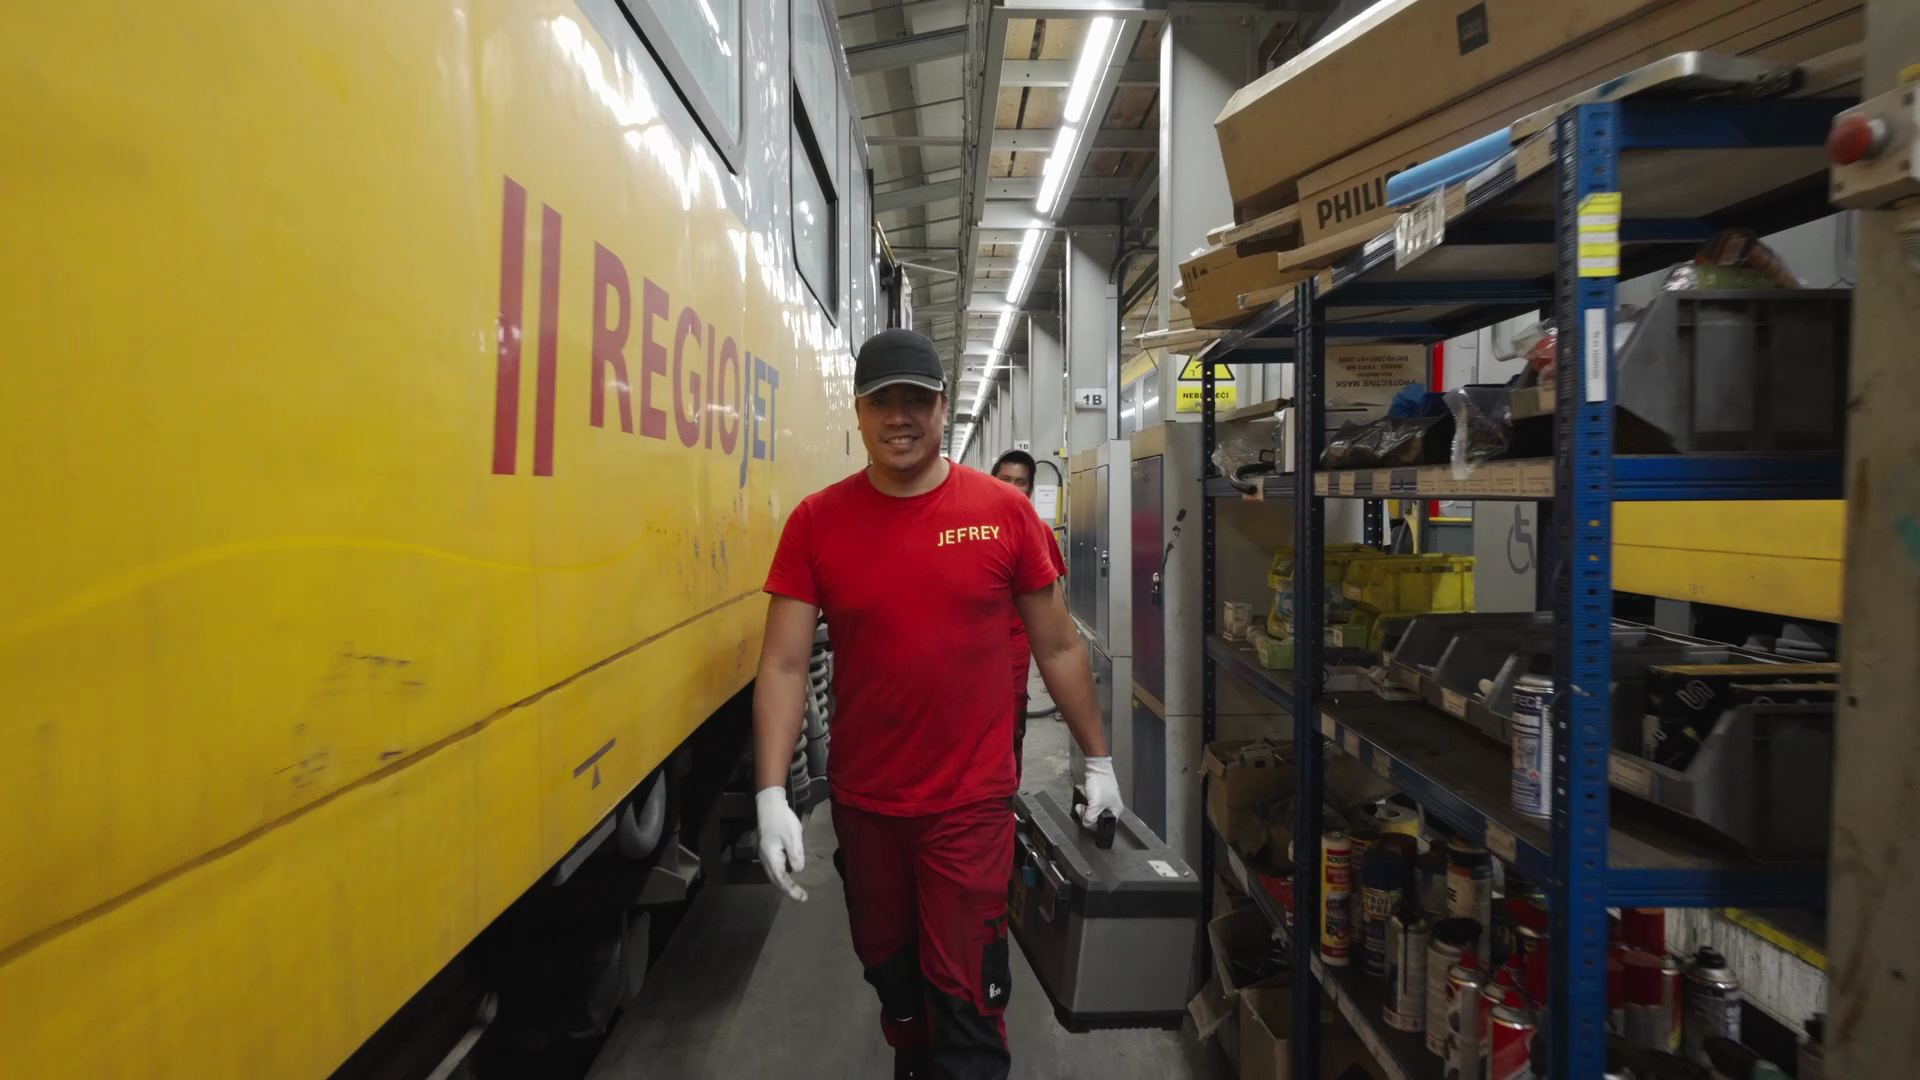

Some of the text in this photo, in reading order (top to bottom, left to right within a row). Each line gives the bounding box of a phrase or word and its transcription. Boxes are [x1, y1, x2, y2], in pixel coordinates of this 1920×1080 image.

[1316, 162, 1420, 230] PHILI
[590, 240, 779, 489] REGIOJET
[1083, 394, 1103, 406] 1B
[1182, 391, 1229, 399] NEBEČÍ
[937, 525, 1000, 547] JEFREY
